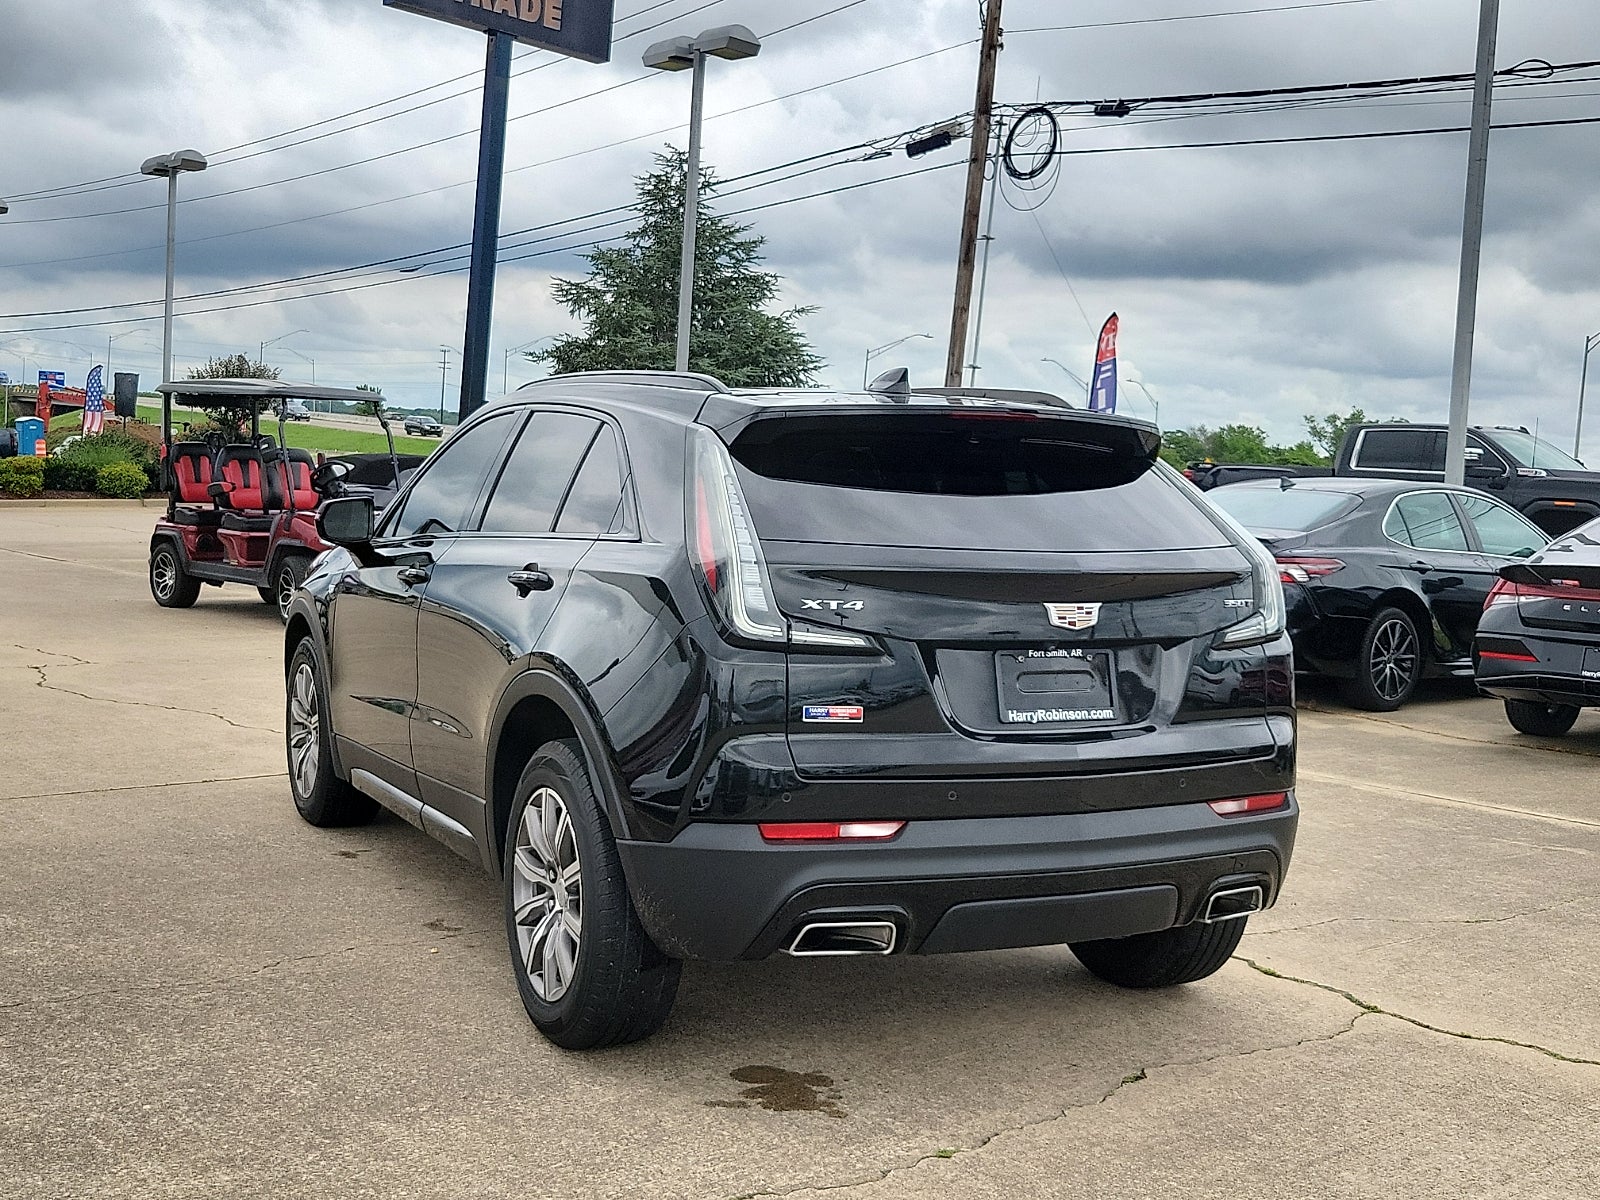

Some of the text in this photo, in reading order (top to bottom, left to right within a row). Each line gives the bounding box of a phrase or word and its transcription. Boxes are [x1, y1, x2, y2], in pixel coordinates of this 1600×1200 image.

[455, 0, 563, 31] ADE
[800, 598, 865, 611] XT4
[1028, 649, 1045, 658] Fort
[1071, 648, 1083, 657] AR
[1008, 708, 1114, 724] HarryRobinson.com
